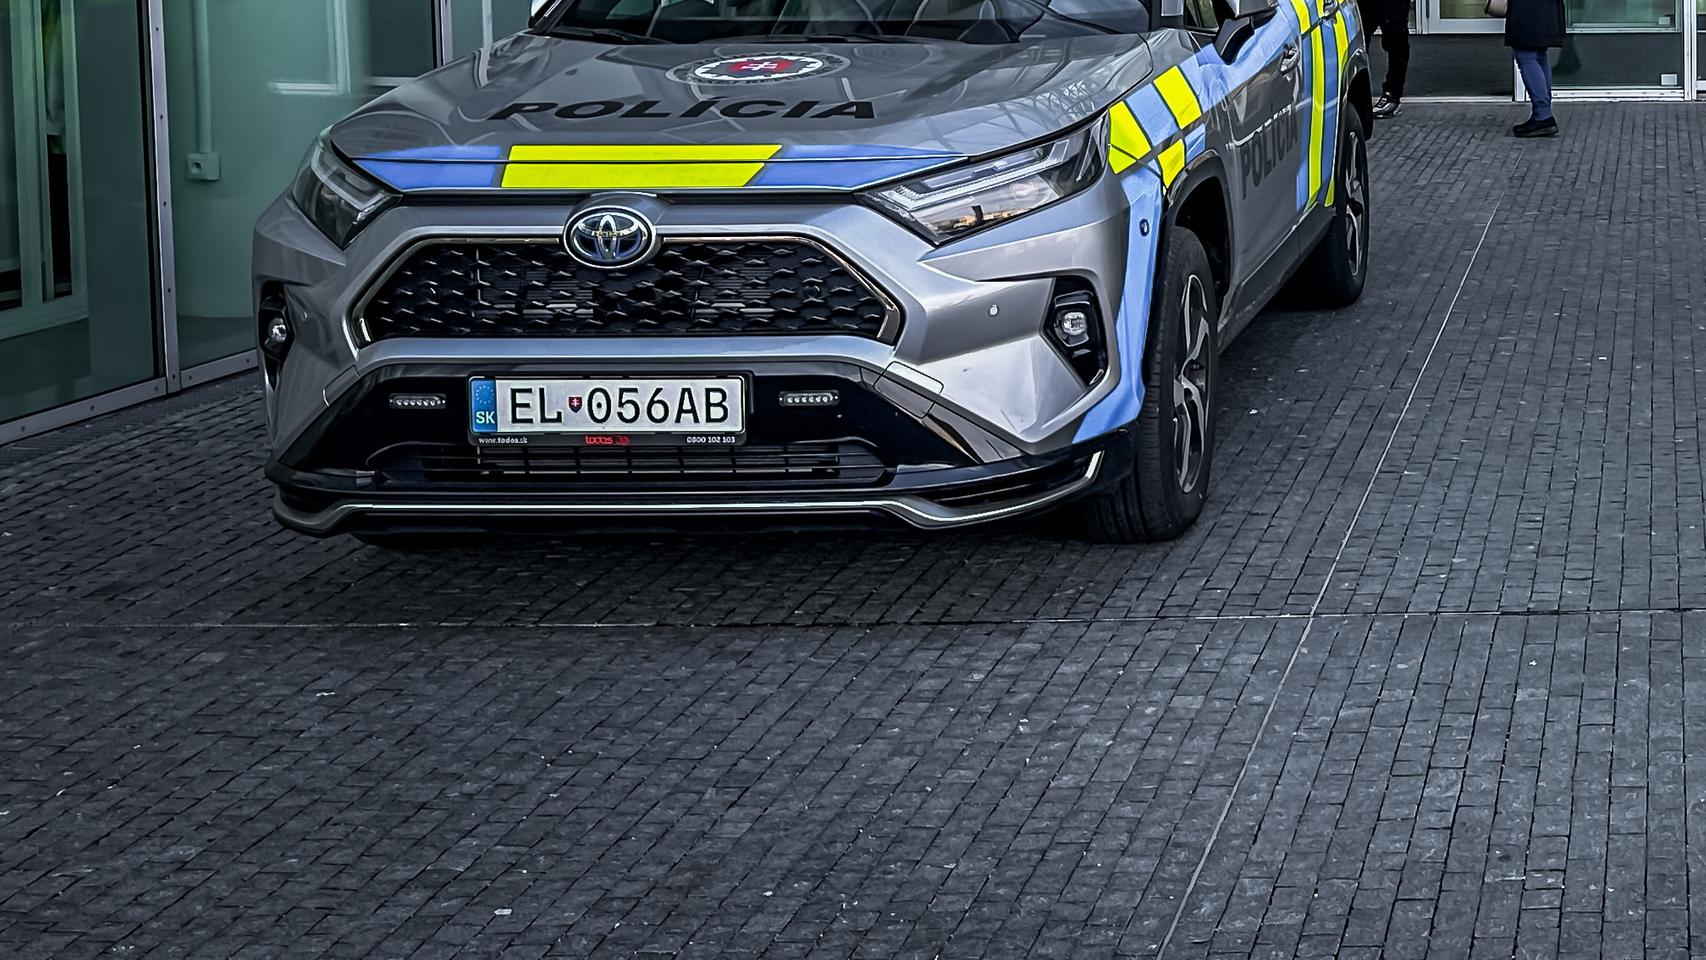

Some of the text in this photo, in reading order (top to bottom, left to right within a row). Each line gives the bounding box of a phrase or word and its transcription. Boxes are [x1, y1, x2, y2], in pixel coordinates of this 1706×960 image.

[486, 96, 876, 120] POLÍCIA
[476, 387, 729, 424] SK EL 056AB
